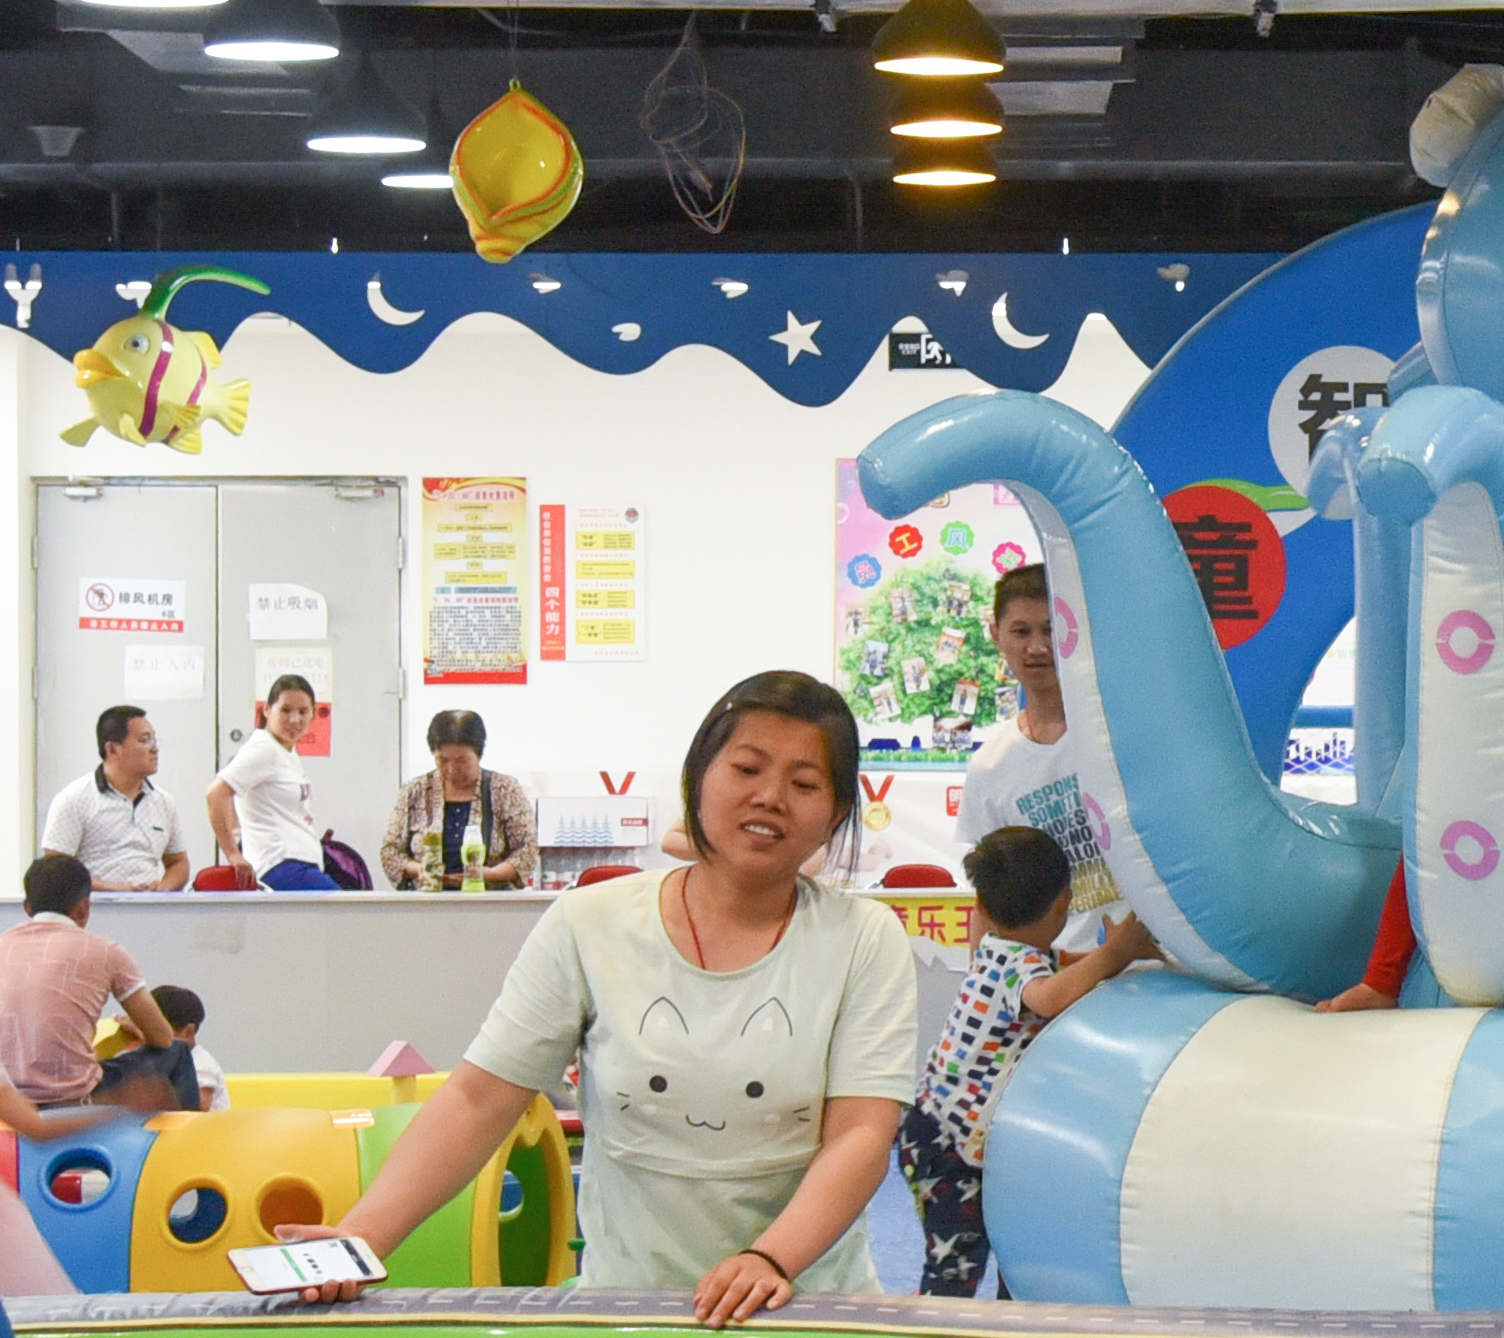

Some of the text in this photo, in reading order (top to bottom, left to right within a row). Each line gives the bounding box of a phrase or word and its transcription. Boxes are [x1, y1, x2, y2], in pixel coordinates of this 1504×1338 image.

[118, 592, 174, 606] 排风机房
[258, 595, 319, 611] 禁止吸烟
[544, 586, 561, 636] 四个能力
